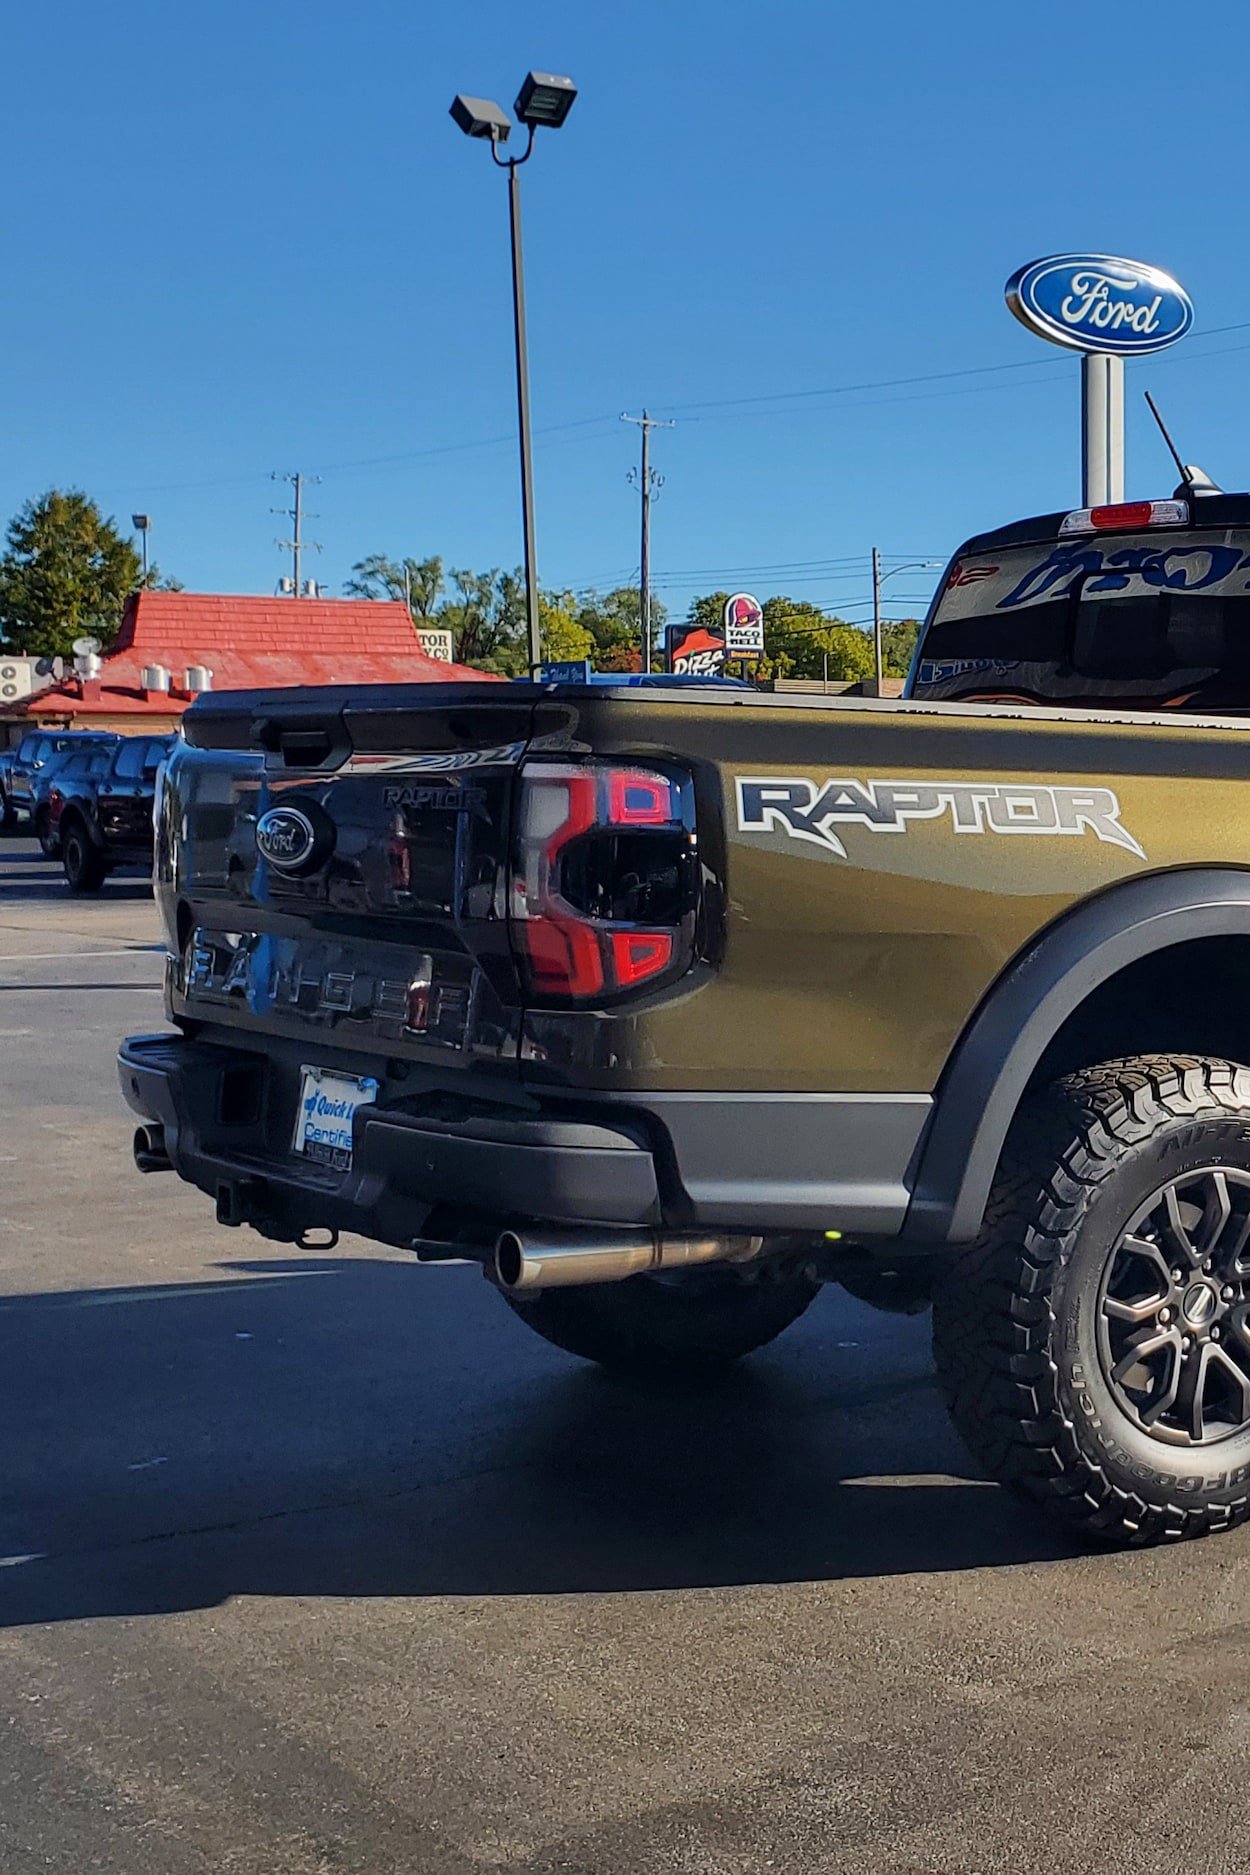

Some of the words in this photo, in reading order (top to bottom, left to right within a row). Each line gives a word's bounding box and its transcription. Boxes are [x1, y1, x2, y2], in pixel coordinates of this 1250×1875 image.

[1061, 272, 1162, 334] Ford
[419, 634, 448, 647] TOR
[728, 629, 760, 638] TACO
[730, 638, 760, 646] BELL
[673, 647, 725, 677] Pizza
[382, 786, 493, 825] RAPTOR
[734, 776, 1148, 861] RAPTOR
[259, 818, 296, 852] Ford
[187, 926, 478, 1052] RANGER
[317, 1095, 347, 1119] Quick
